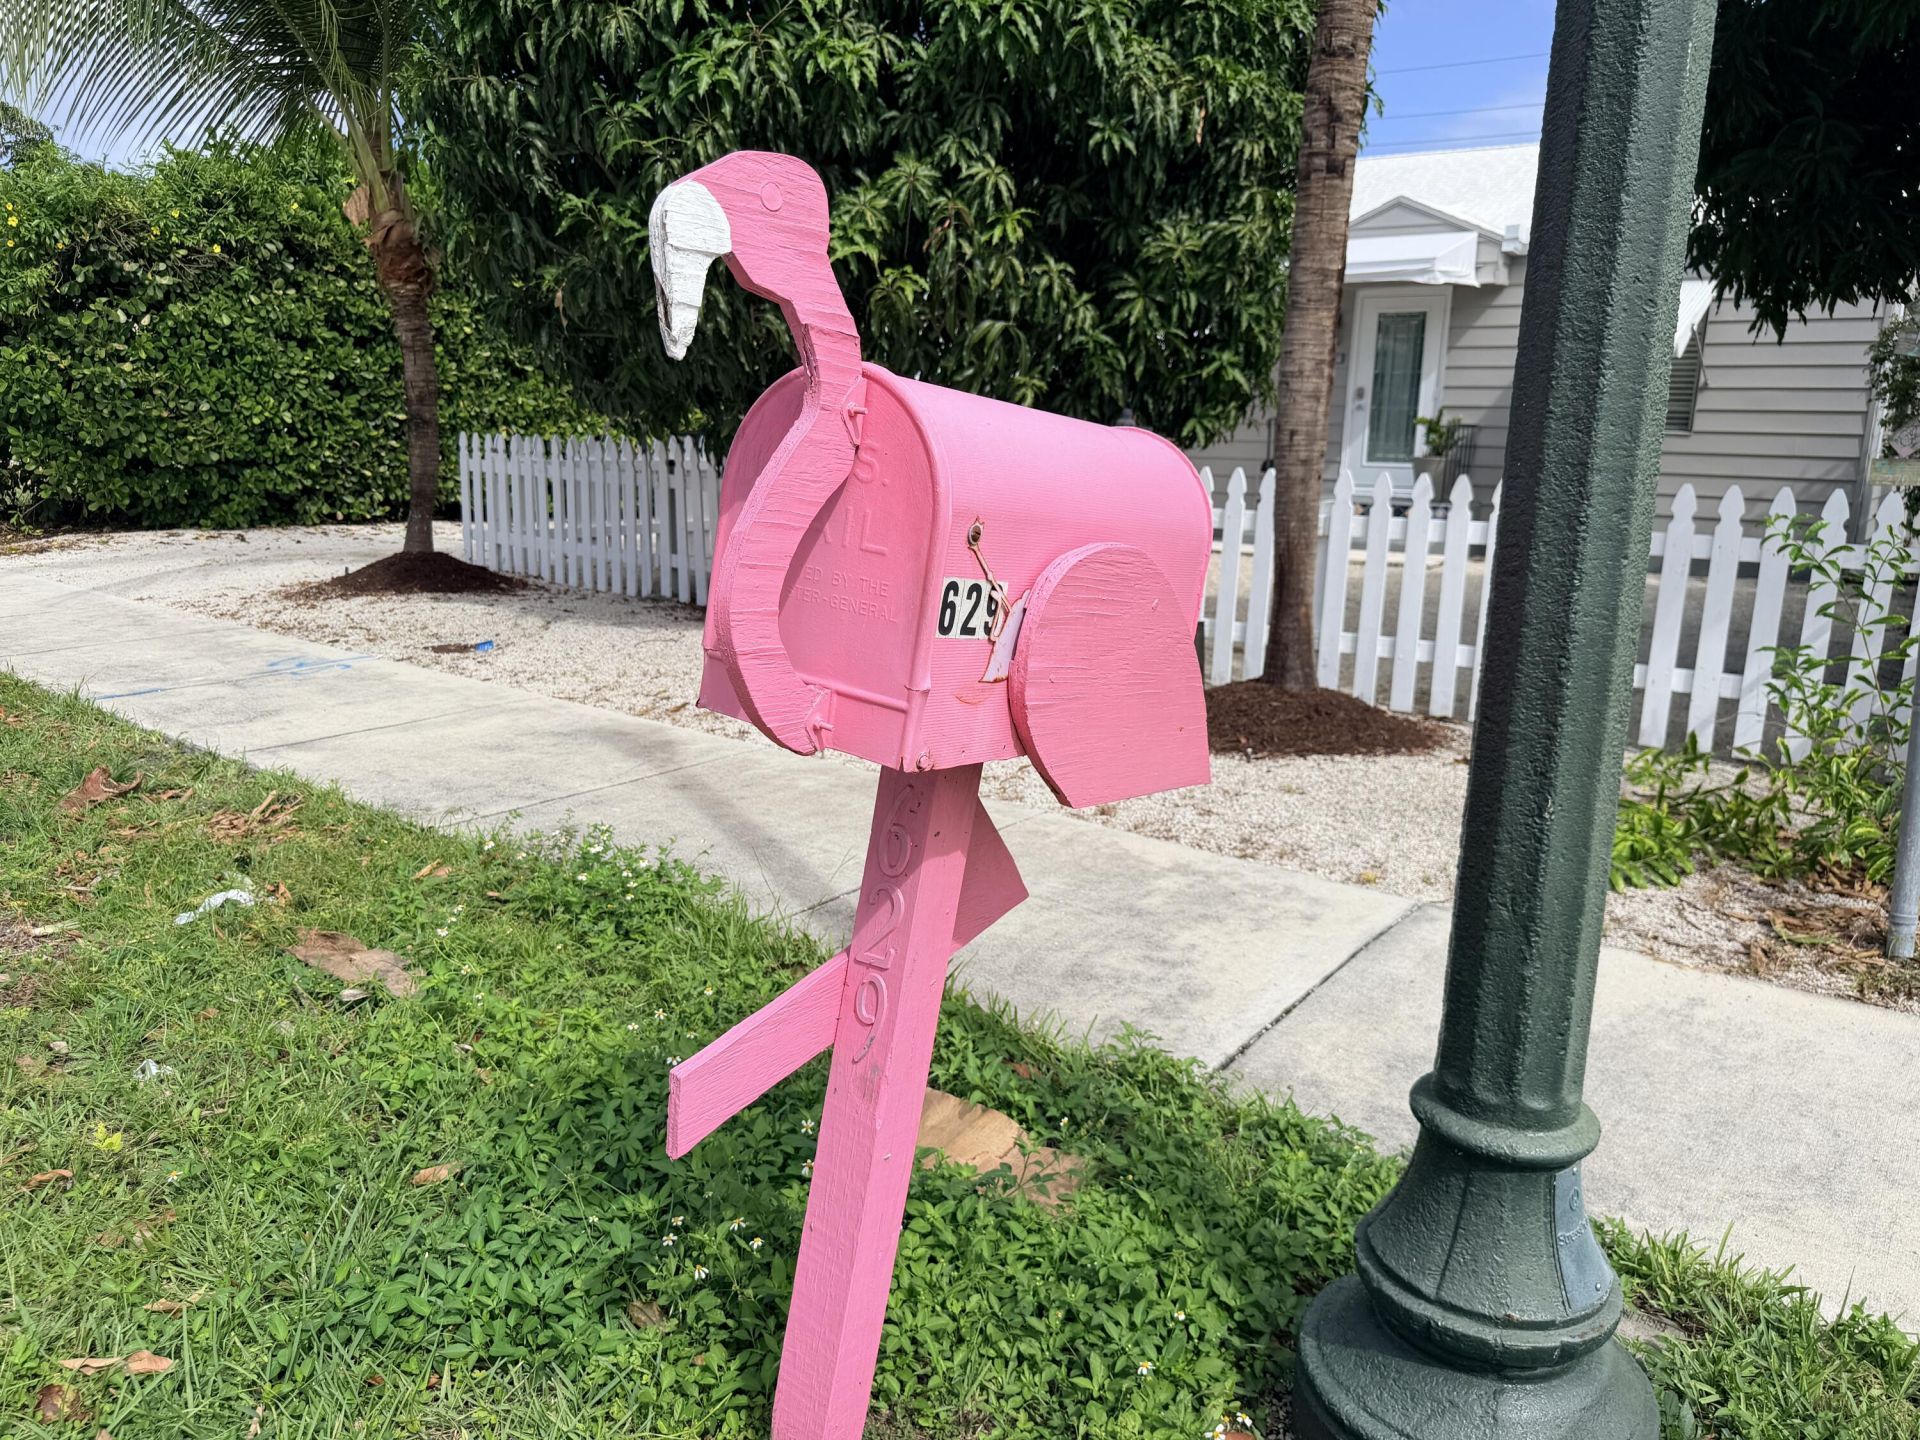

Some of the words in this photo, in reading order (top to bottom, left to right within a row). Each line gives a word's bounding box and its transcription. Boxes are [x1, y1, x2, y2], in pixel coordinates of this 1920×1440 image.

[831, 569, 852, 590] BY
[858, 575, 890, 599] THE
[937, 580, 1004, 637] 629
[852, 783, 912, 1064] 629
